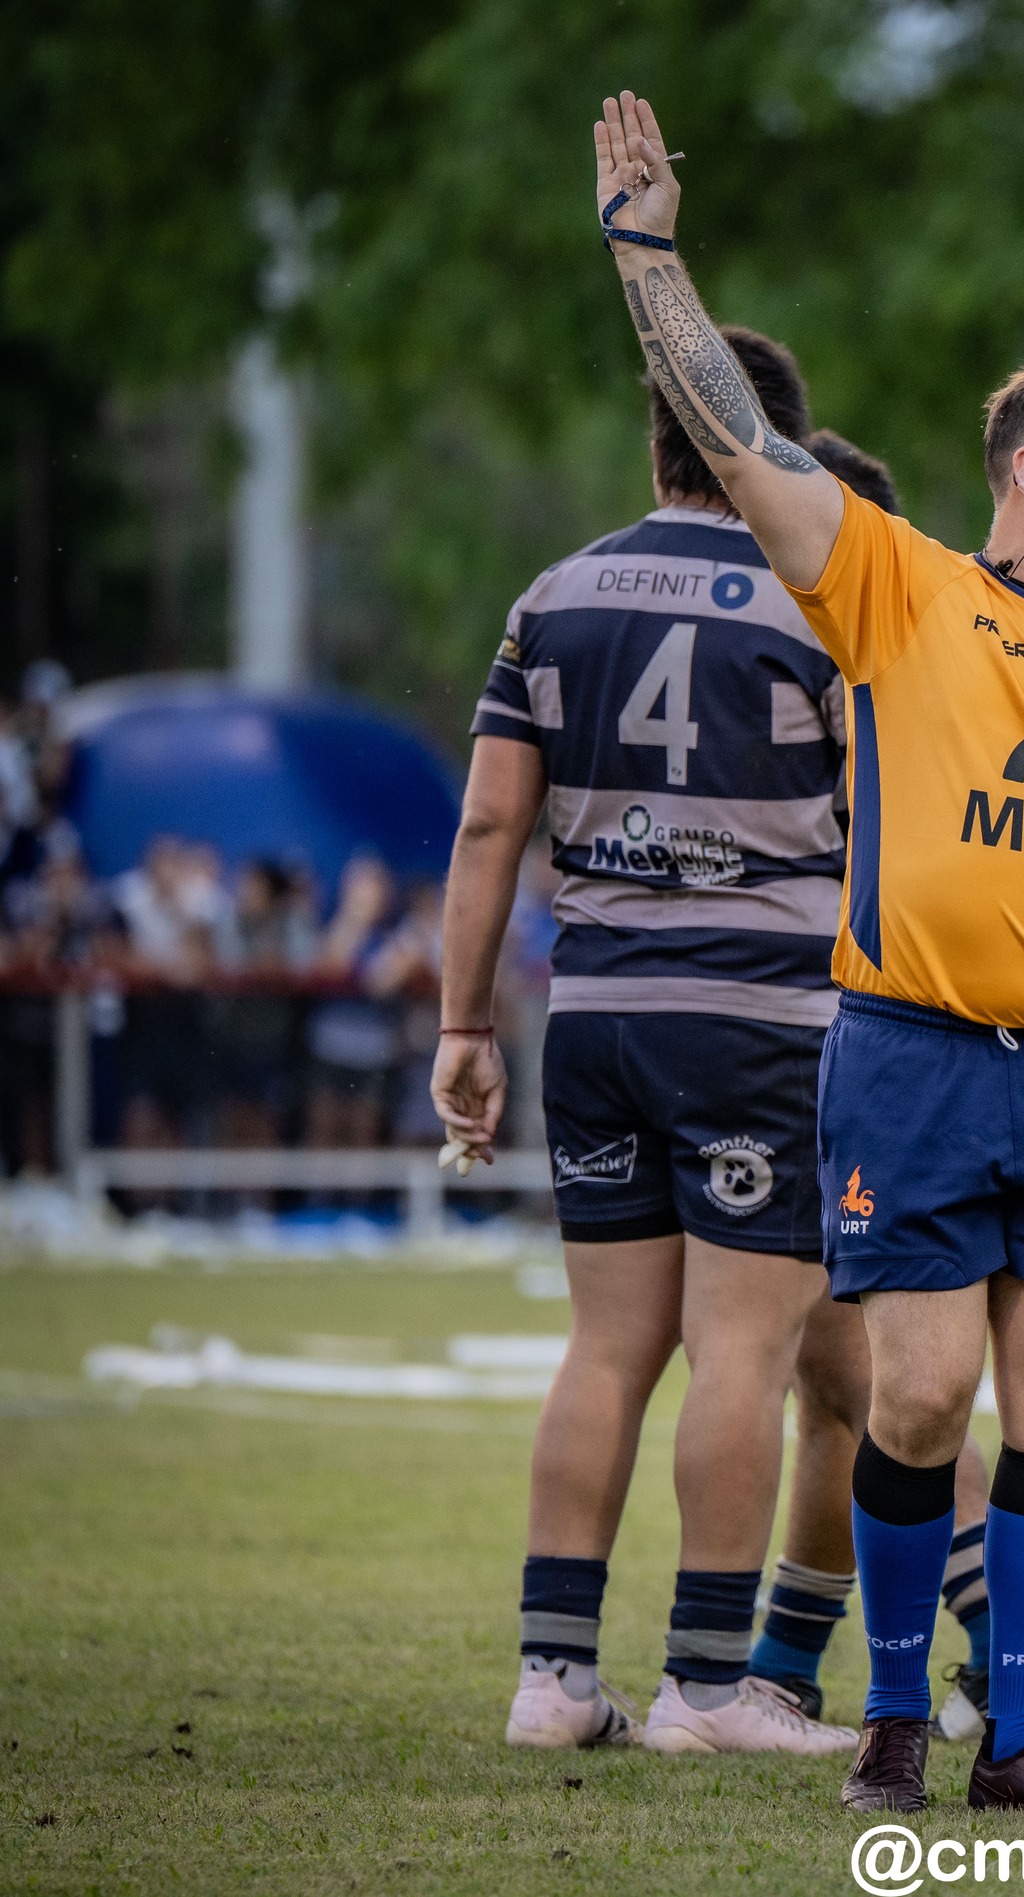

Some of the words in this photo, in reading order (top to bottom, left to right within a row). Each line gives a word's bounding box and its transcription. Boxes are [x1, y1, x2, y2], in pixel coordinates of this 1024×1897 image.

[596, 568, 707, 598] DEFINIT
[618, 621, 699, 787] 4
[654, 826, 735, 847] GRUPO
[840, 1220, 870, 1235] URT
